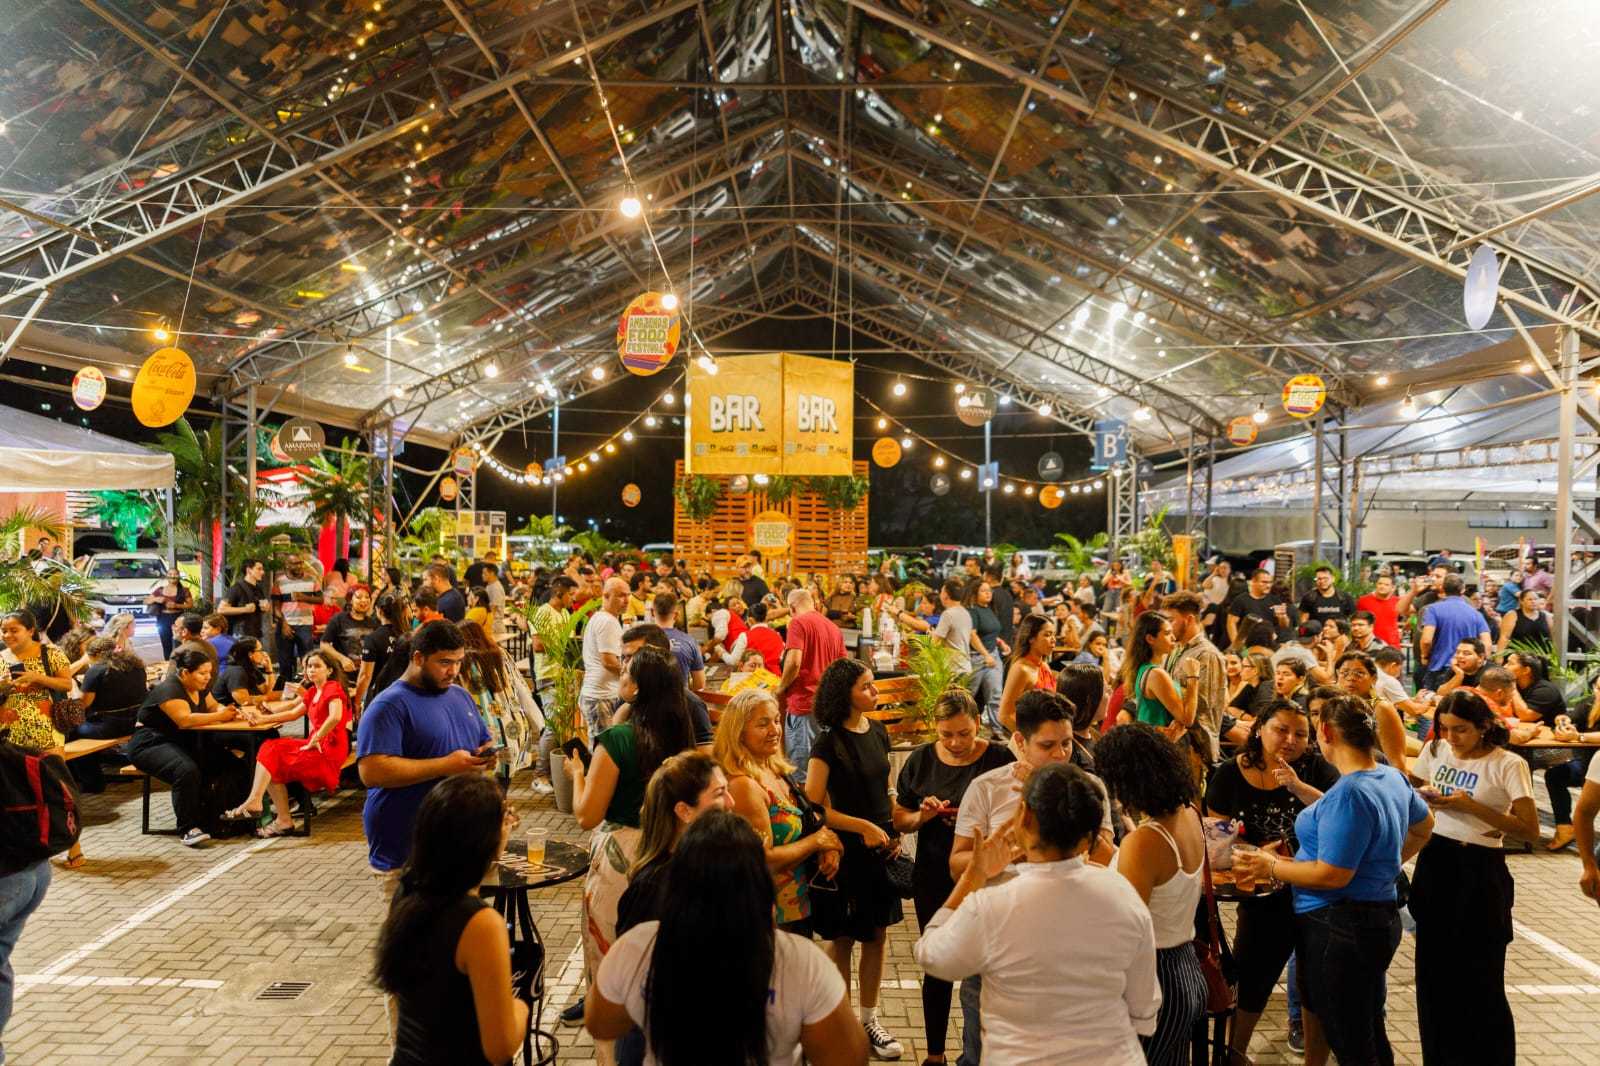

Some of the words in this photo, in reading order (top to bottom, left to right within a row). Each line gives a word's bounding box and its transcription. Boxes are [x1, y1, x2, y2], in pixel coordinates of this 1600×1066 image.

[629, 317, 669, 329] AMAZONAS
[628, 329, 666, 343] FOOD
[626, 342, 665, 354] FESTIVAL
[710, 394, 765, 432] BAR
[798, 394, 839, 433] BAR
[284, 441, 321, 449] AMAZONAS
[1434, 765, 1479, 790] GOOD
